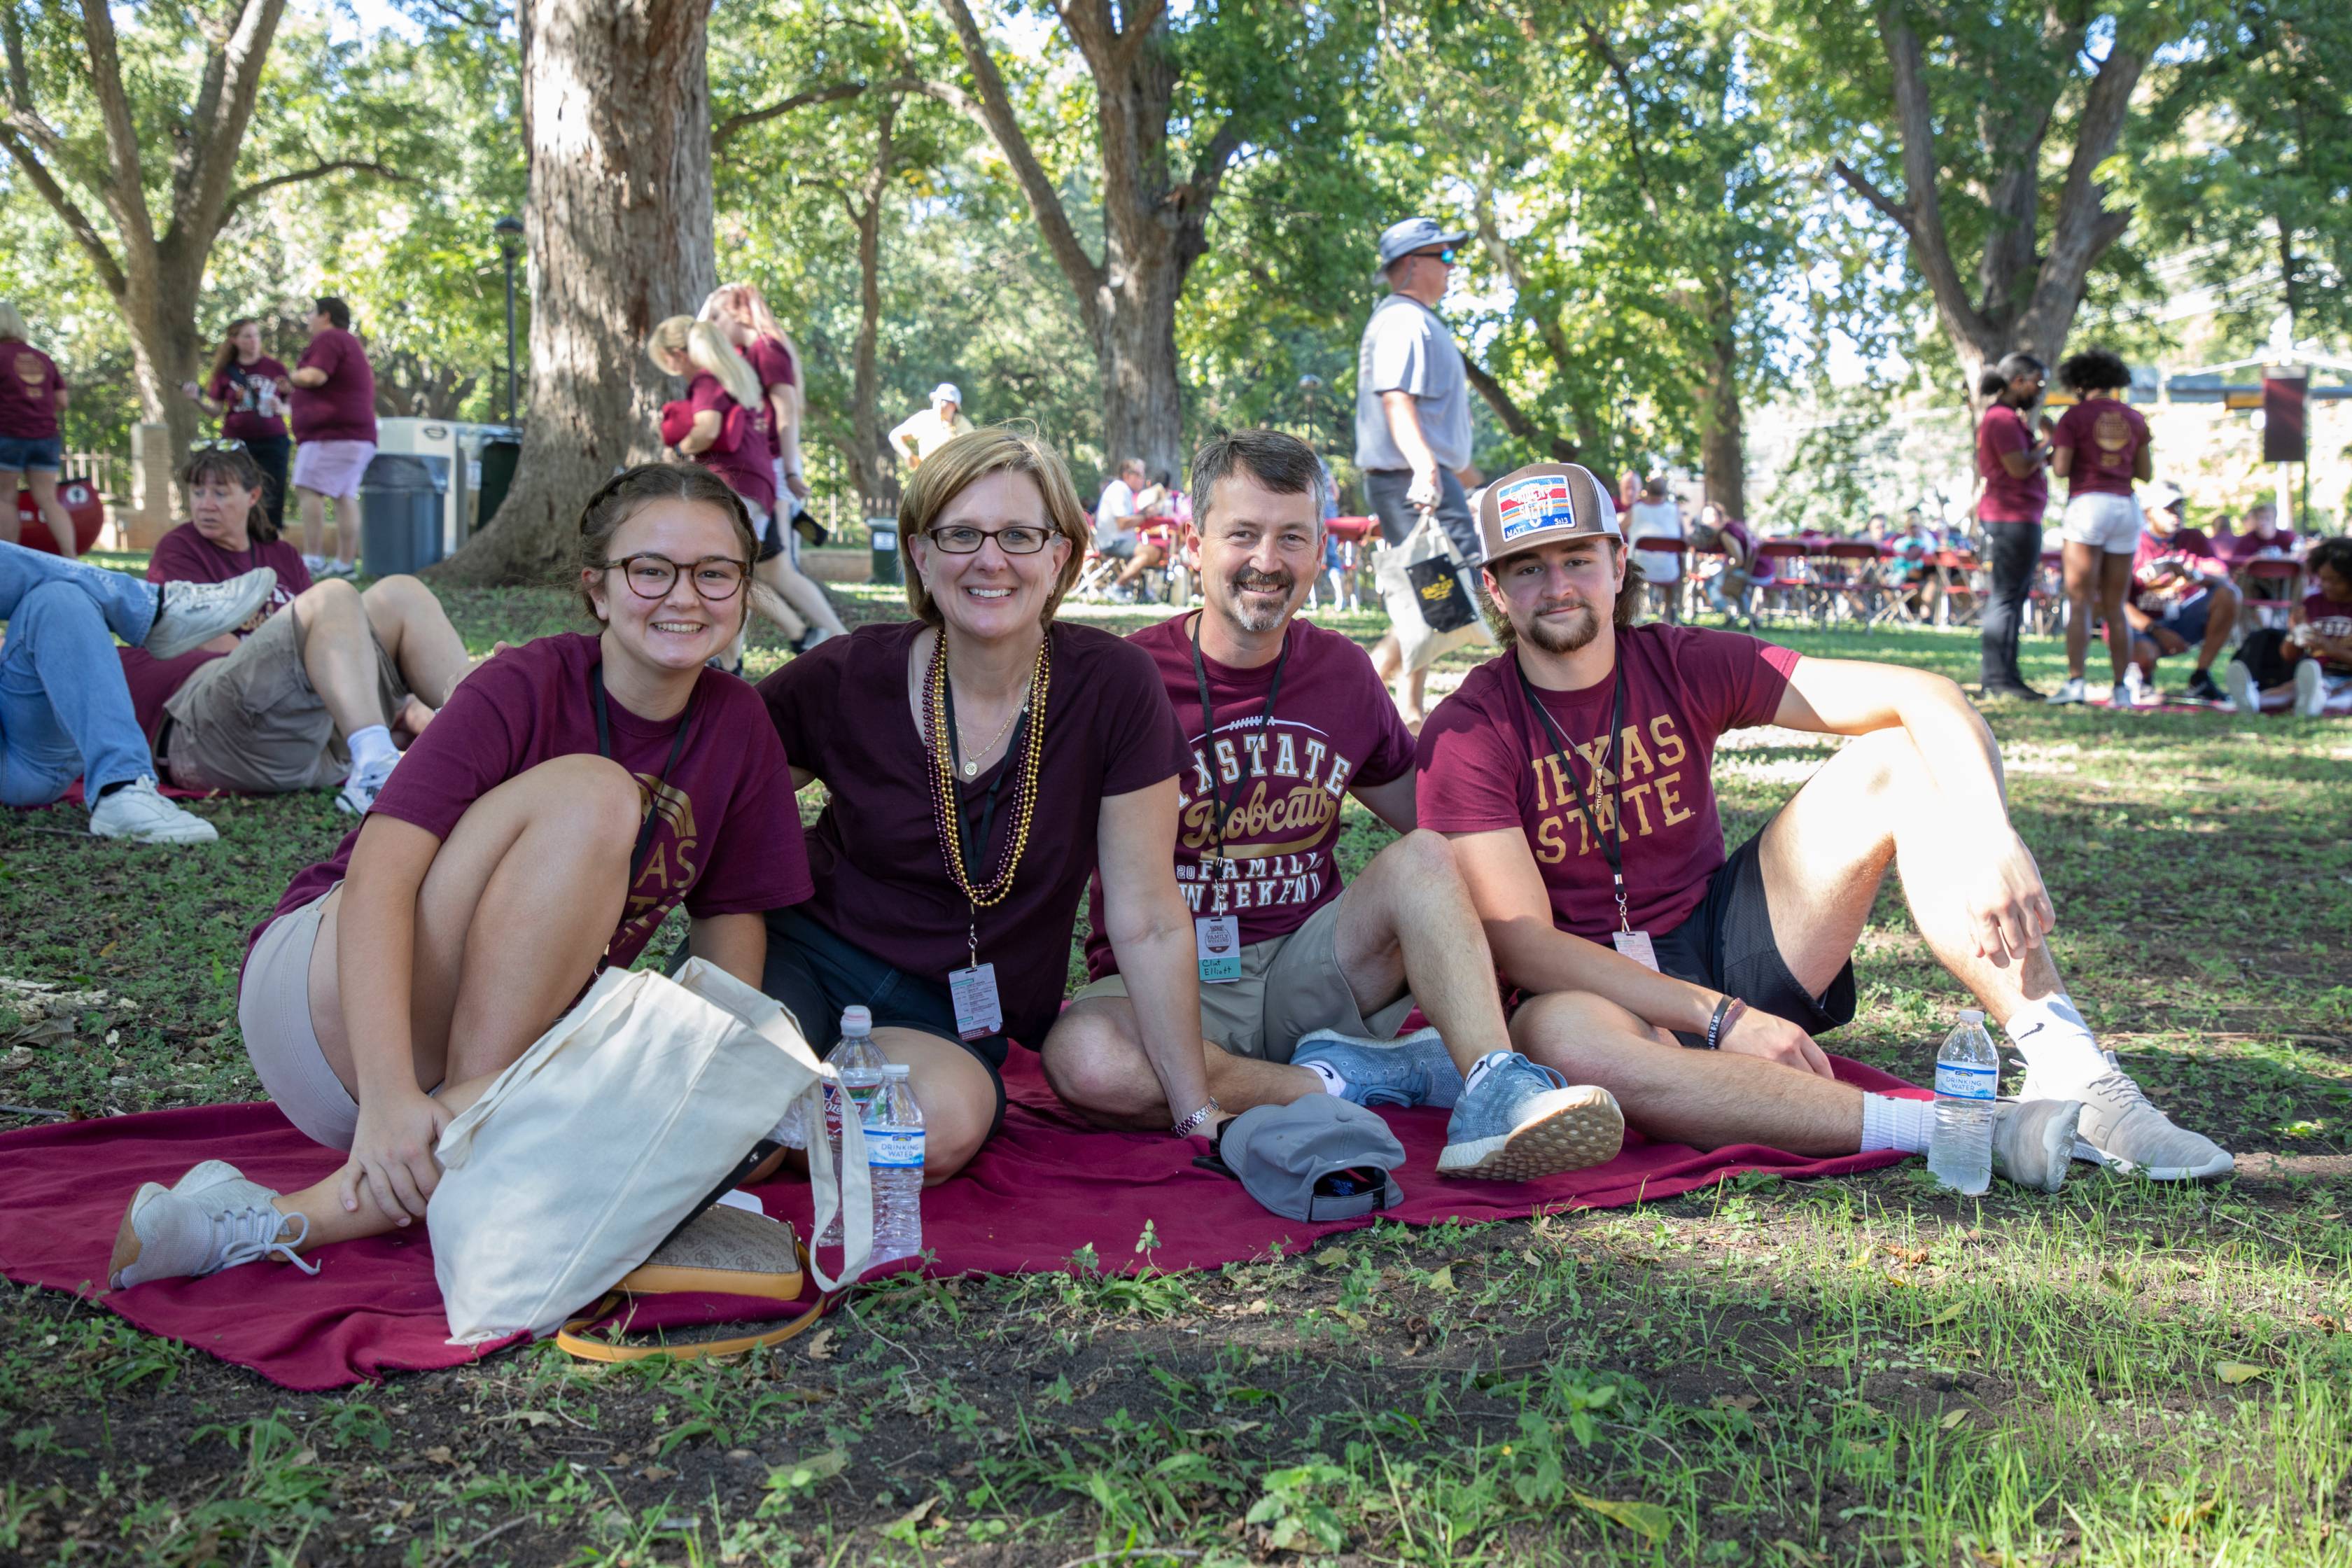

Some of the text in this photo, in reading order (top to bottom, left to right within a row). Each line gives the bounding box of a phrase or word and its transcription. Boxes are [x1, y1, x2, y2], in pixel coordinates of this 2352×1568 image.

[1506, 524, 1526, 537] MATT
[1179, 733, 1352, 811] XSTATE
[1531, 713, 1686, 811] TEXAS
[1182, 775, 1336, 848] Bobcats
[1536, 771, 1691, 864] STATE
[1177, 865, 1196, 880] 20
[1198, 851, 1317, 881] FAMILY
[1179, 872, 1322, 913] WEEKEND
[1946, 1077, 1982, 1086] DRINKING
[1952, 1082, 1975, 1091] WATER
